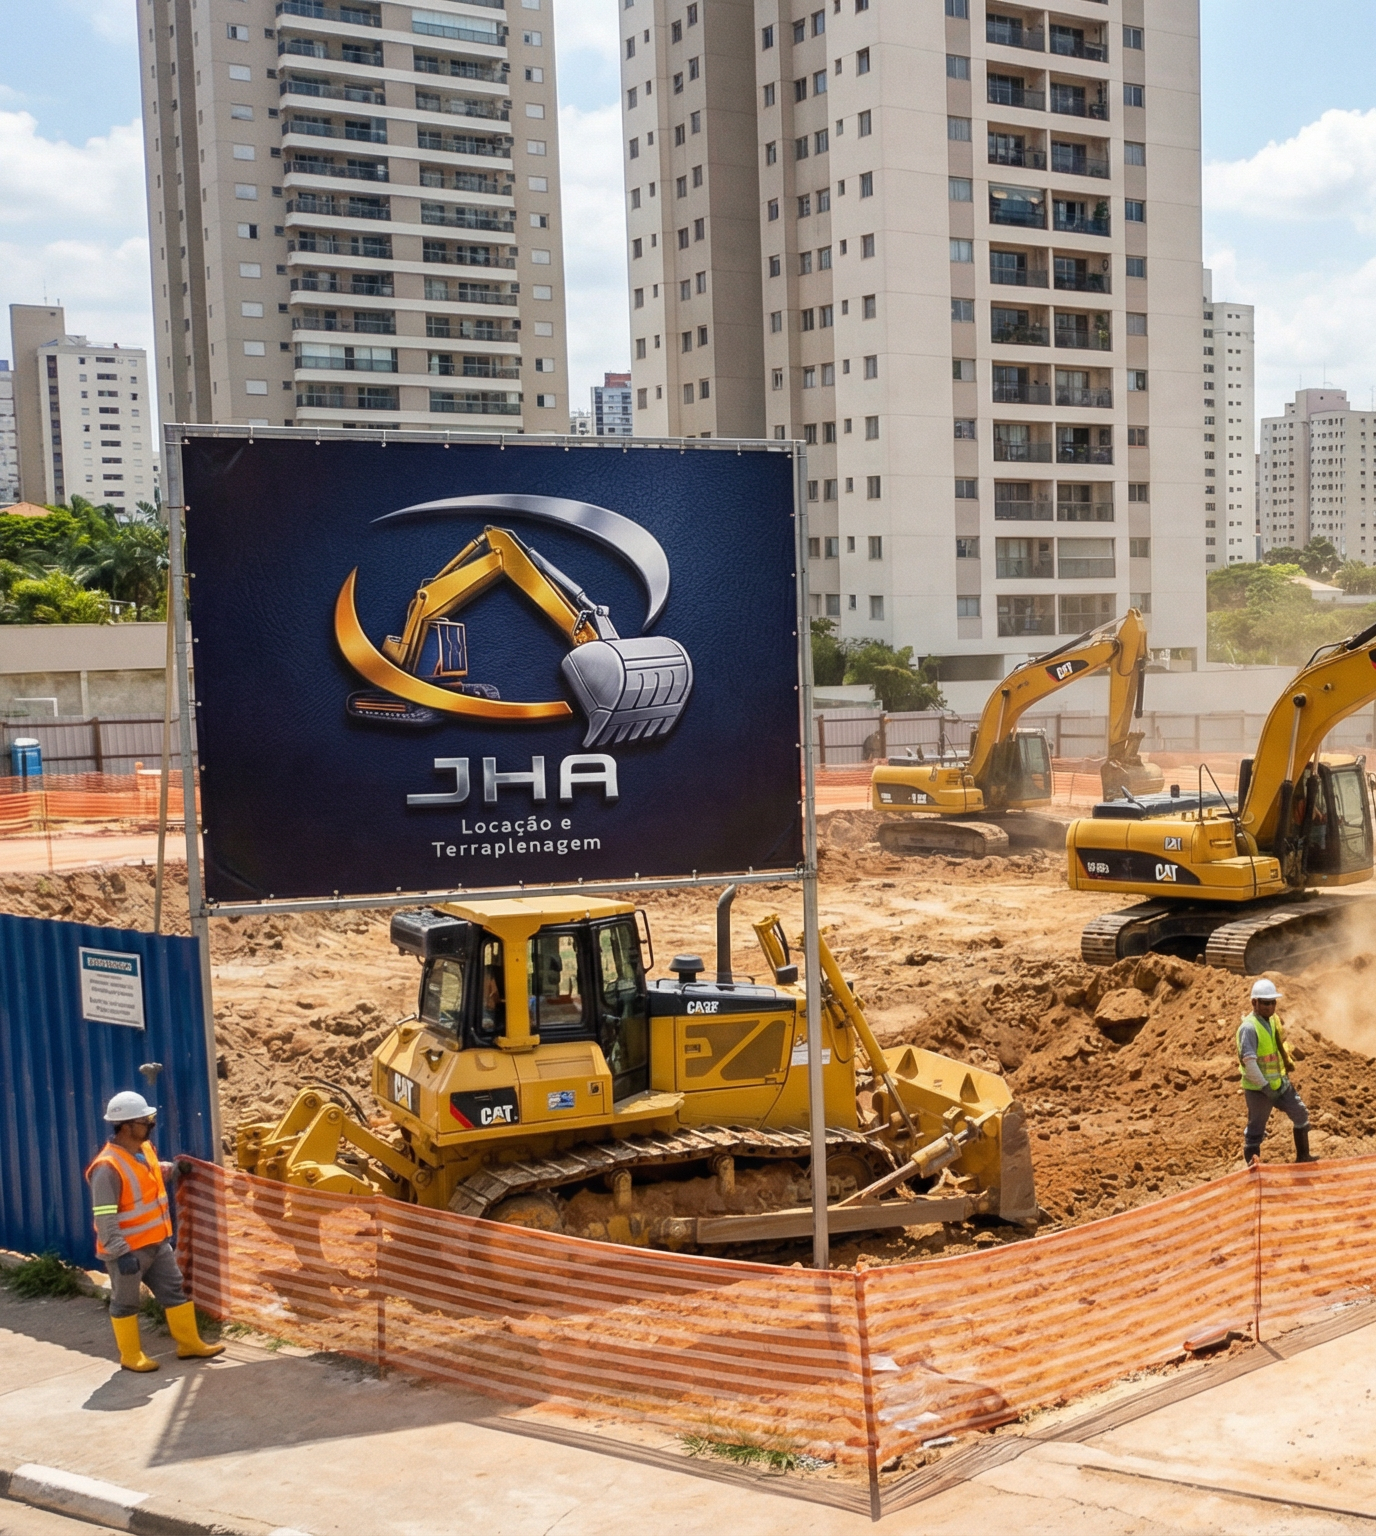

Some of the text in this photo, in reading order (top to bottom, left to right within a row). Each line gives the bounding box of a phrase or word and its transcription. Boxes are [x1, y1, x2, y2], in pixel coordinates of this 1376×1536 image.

[406, 753, 619, 806] JHA
[461, 815, 572, 837] Locação e
[431, 836, 602, 859] Terraplenagem
[1155, 863, 1179, 882] CAT
[393, 1071, 414, 1112] CAT
[480, 1104, 513, 1126] CAT
